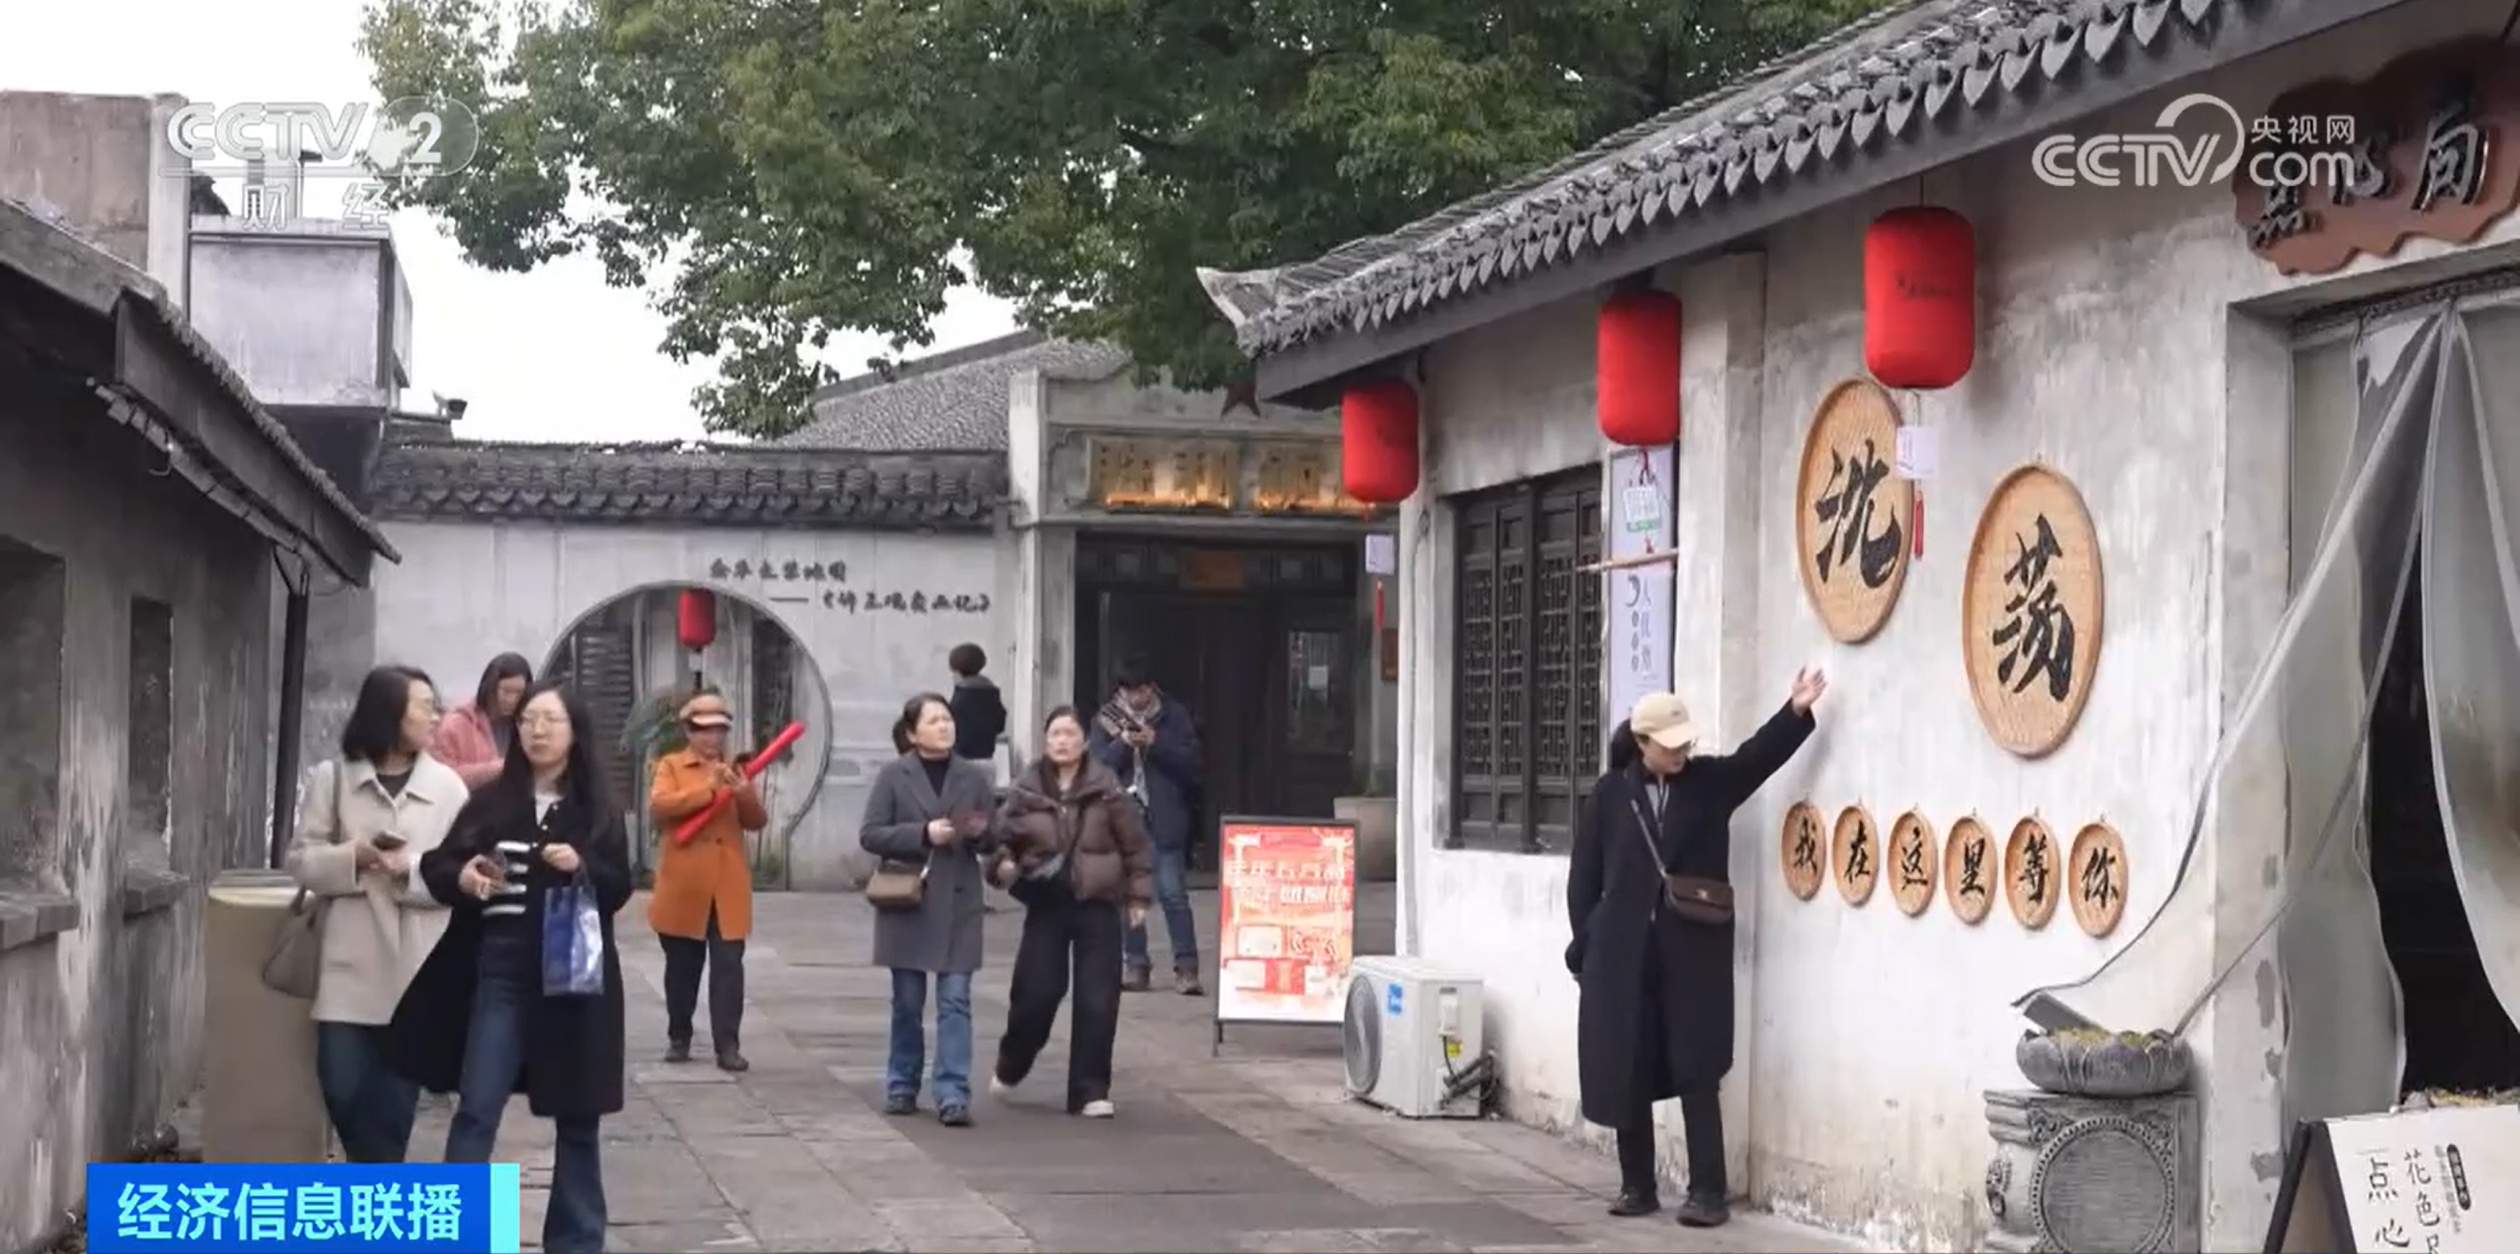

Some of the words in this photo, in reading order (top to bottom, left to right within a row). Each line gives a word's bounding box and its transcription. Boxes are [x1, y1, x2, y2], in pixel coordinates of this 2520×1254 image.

[1793, 816, 2121, 909] 我在这里等你
